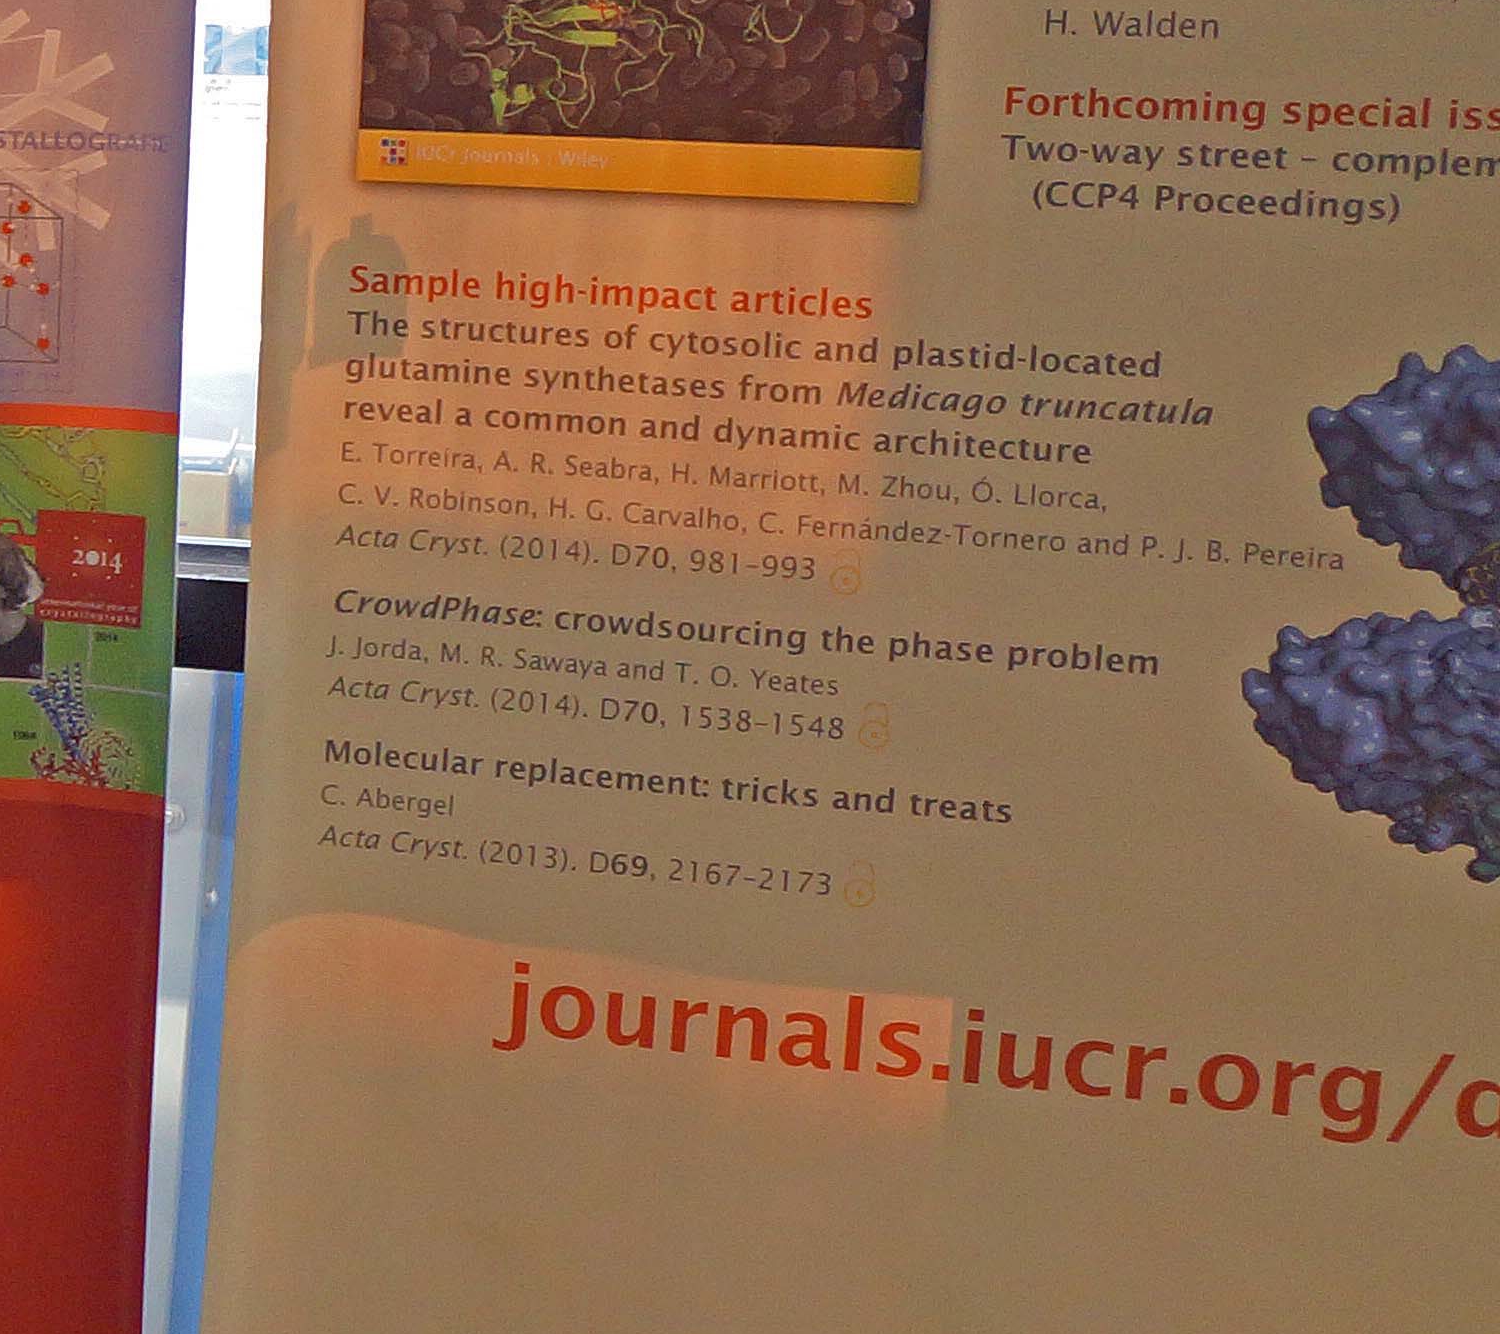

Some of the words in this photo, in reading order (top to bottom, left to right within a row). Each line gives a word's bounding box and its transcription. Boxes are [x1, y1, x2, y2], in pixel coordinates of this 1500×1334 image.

[1033, 180, 1138, 209] (CCP4
[1156, 185, 1399, 225] Proceedings)
[348, 310, 408, 337] The
[422, 318, 589, 347] structures
[605, 323, 638, 349] of
[650, 331, 801, 359] cytosolic
[815, 337, 878, 362] and
[894, 338, 1161, 377] plastid-located
[73, 549, 122, 573] 2014
